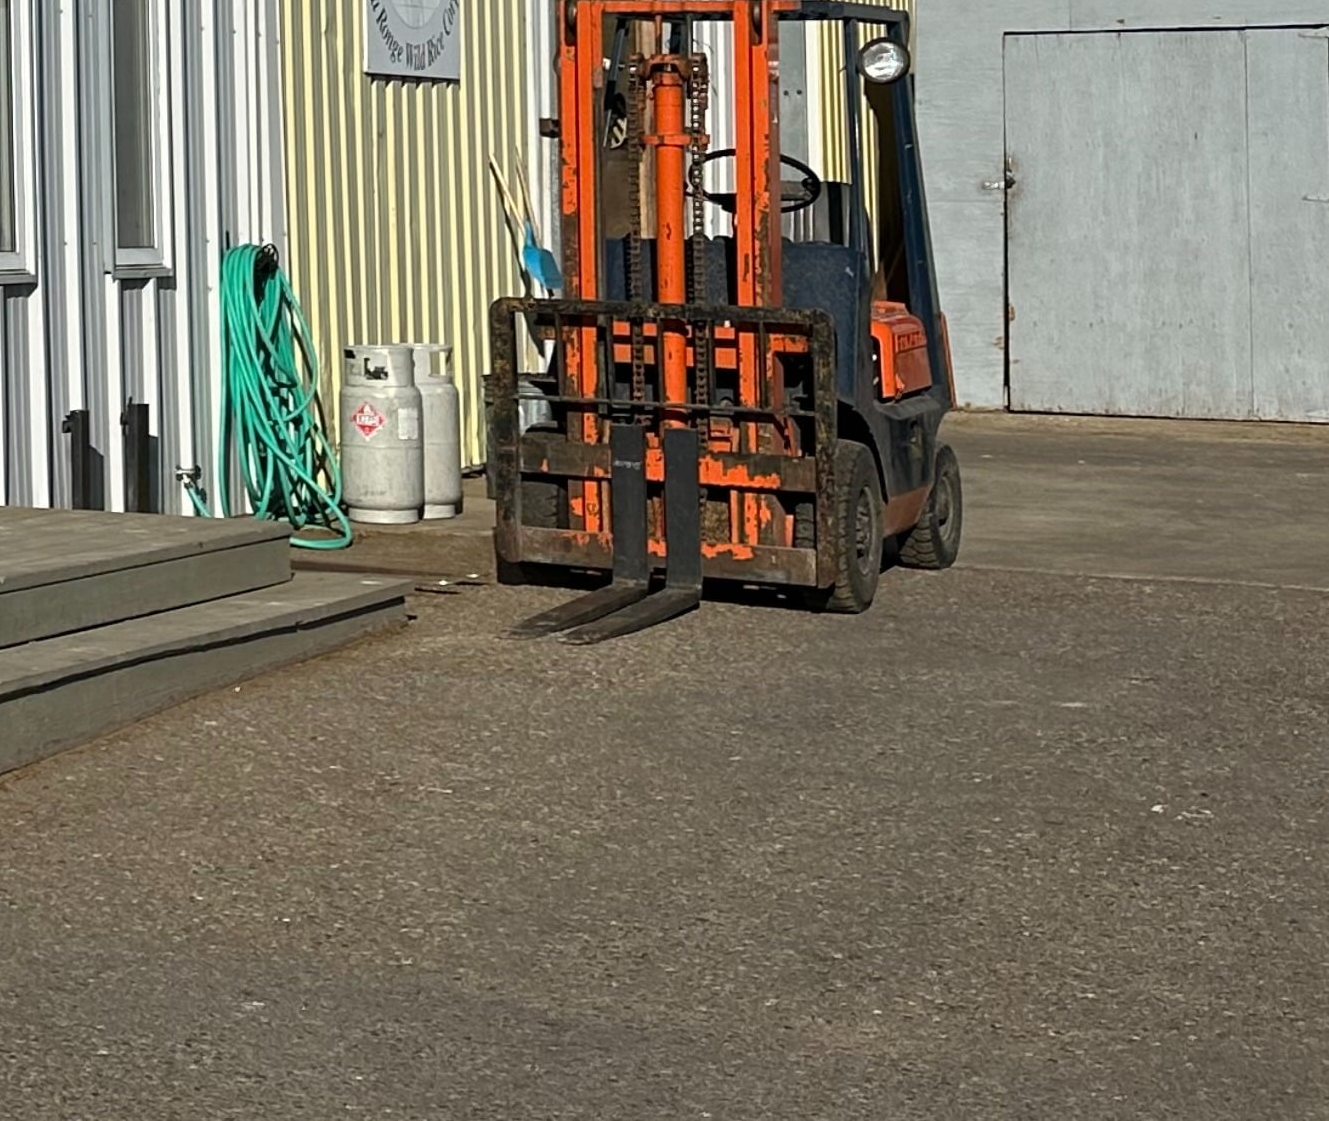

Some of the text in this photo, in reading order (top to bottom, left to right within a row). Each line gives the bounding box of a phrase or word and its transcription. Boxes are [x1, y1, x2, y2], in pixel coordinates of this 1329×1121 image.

[376, 7, 404, 64] Ronge
[406, 42, 426, 71] Wild
[427, 31, 444, 67] Rice
